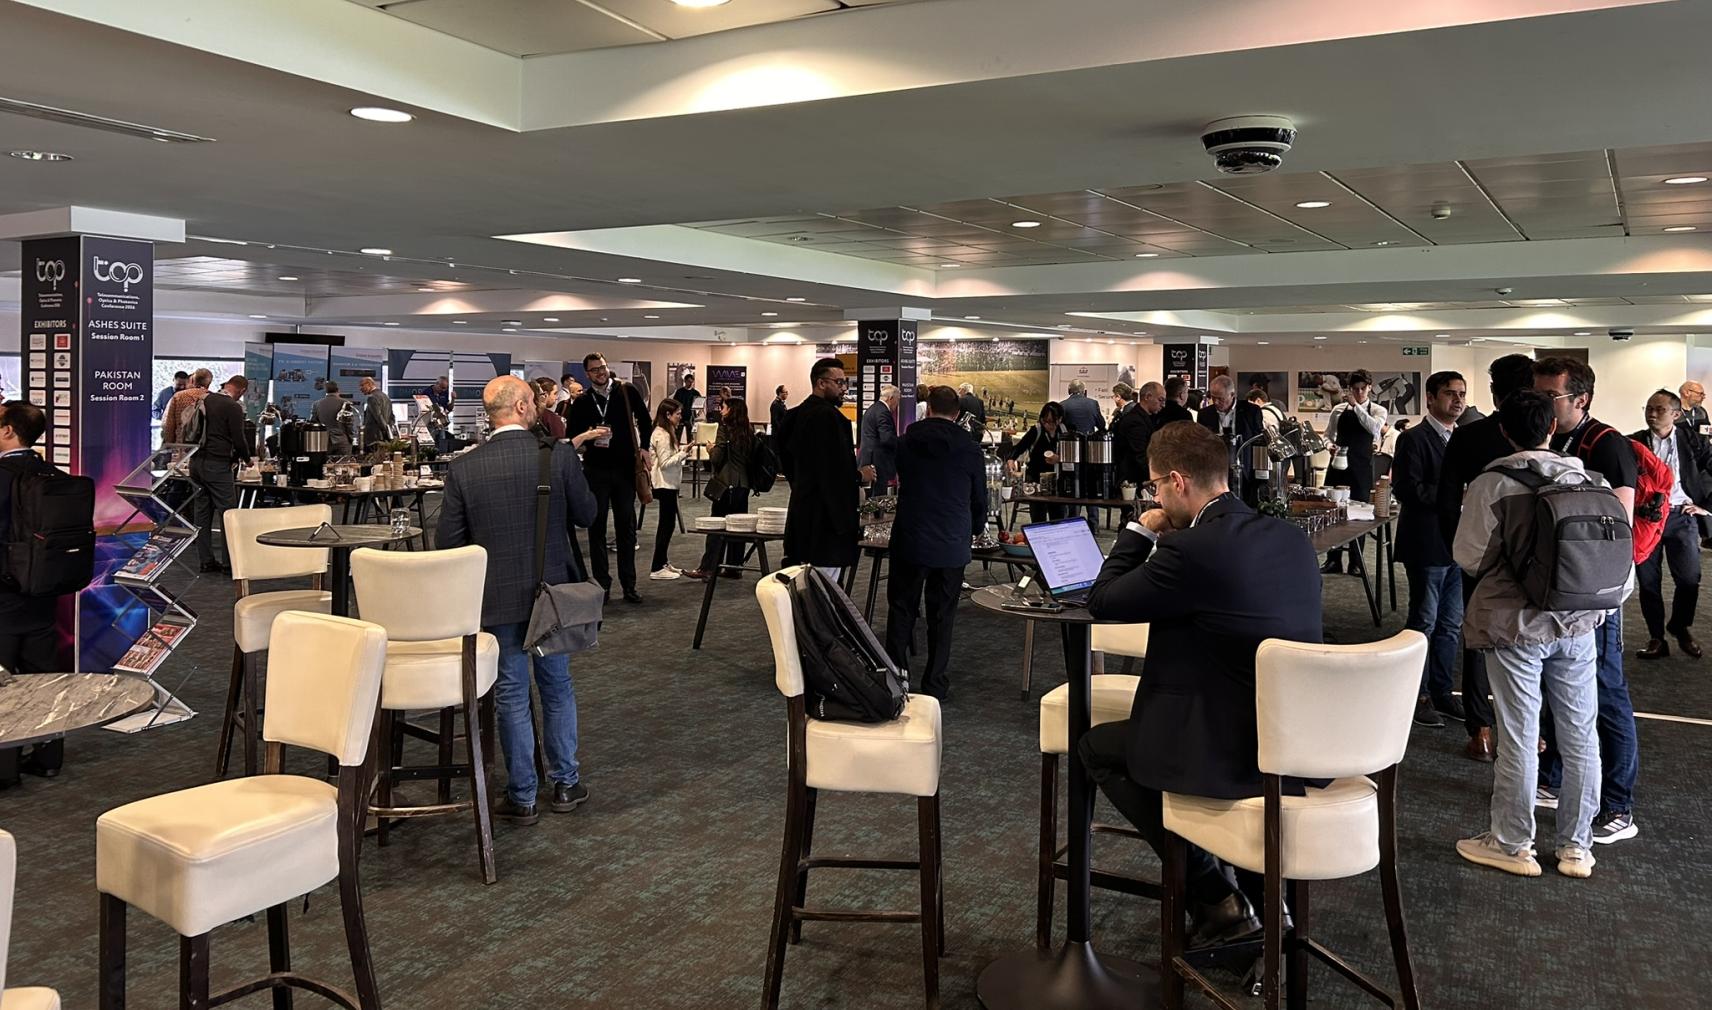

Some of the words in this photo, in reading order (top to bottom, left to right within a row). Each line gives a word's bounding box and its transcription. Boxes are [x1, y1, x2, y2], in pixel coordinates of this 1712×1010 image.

[36, 257, 65, 291] top
[93, 256, 143, 292] top
[34, 320, 67, 329] EXHIBITORS
[88, 319, 119, 329] ASHES
[120, 321, 147, 330] SUITE
[91, 332, 119, 340] Session
[94, 371, 141, 379] PAKISTAN
[102, 382, 133, 390] ROOM
